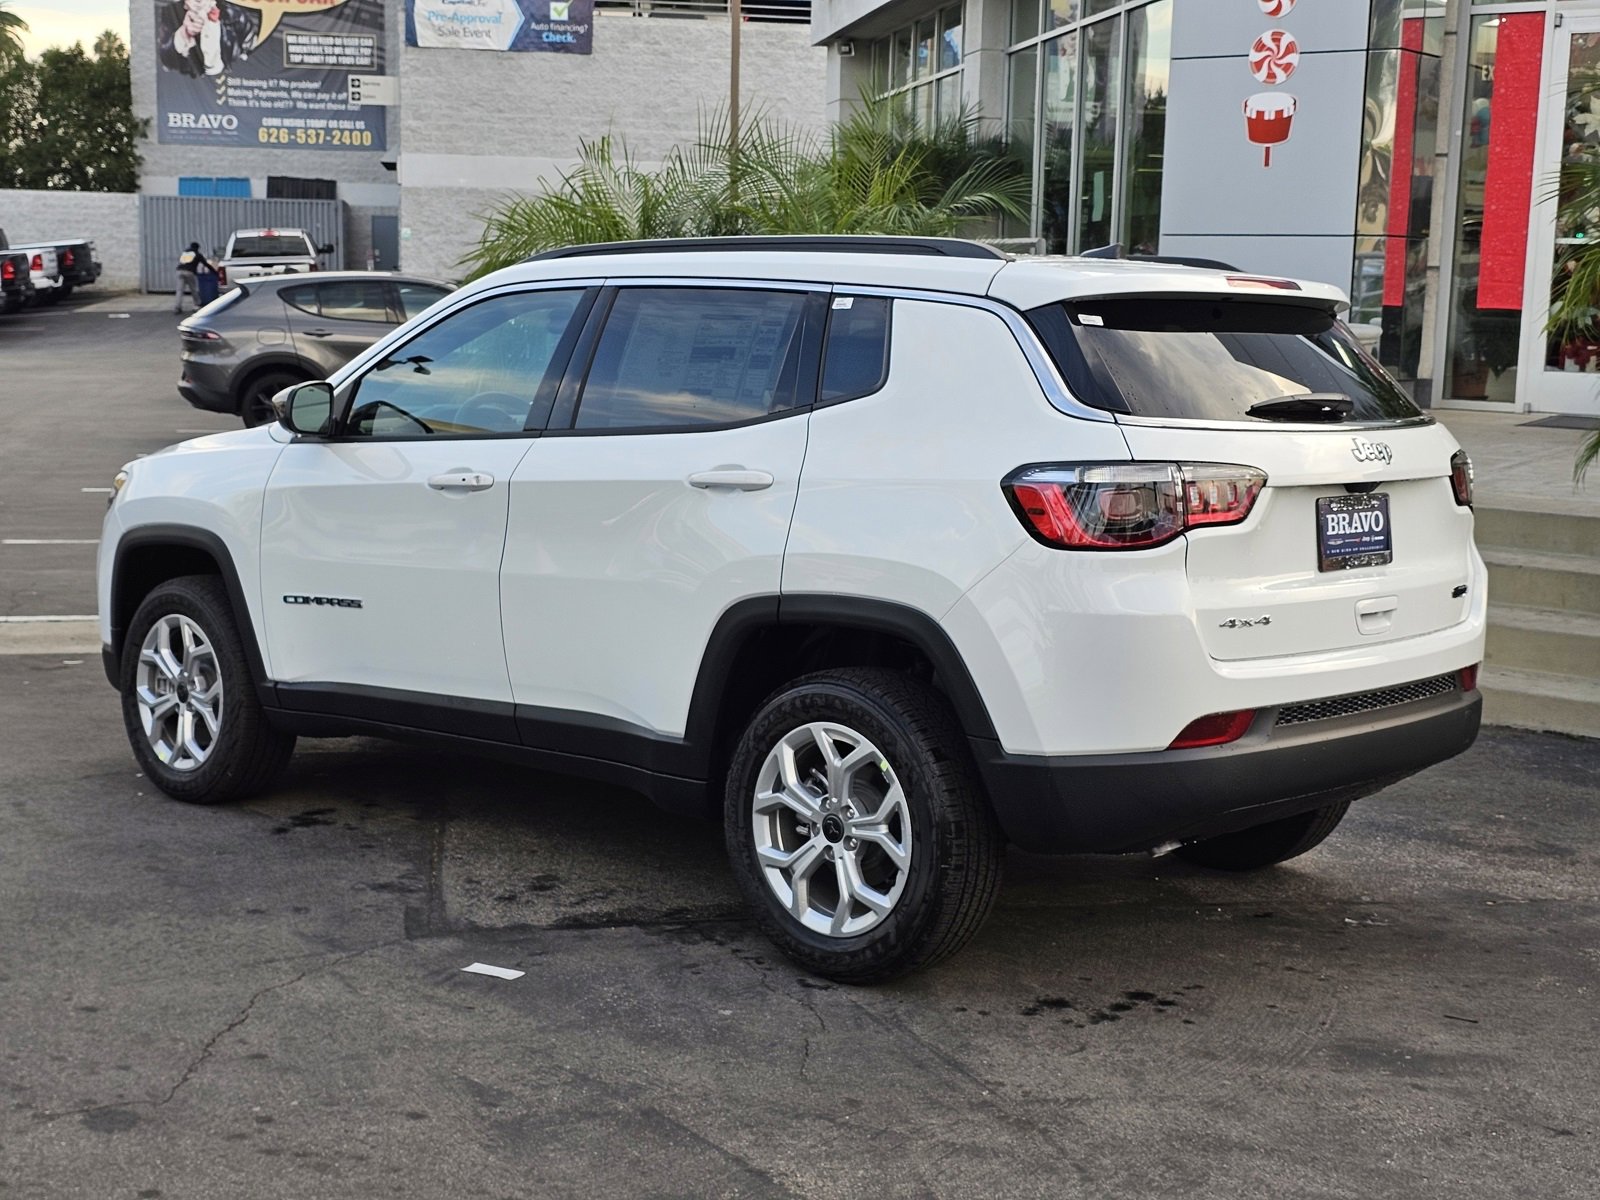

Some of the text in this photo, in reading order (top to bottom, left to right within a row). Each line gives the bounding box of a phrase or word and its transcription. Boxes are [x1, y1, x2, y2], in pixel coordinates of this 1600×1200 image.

[427, 11, 502, 25] Pre-Approval
[438, 26, 492, 38] Sale Event
[531, 22, 588, 34] Auto financing?
[542, 31, 576, 43] Check.
[279, 80, 289, 88] No
[167, 112, 239, 130] BRAVO
[258, 127, 372, 146] 626-537-2400
[1351, 437, 1393, 466] Jeep
[1326, 510, 1385, 536] BRAVO
[283, 595, 363, 609] COMPASS
[1218, 614, 1272, 629] 4x4
